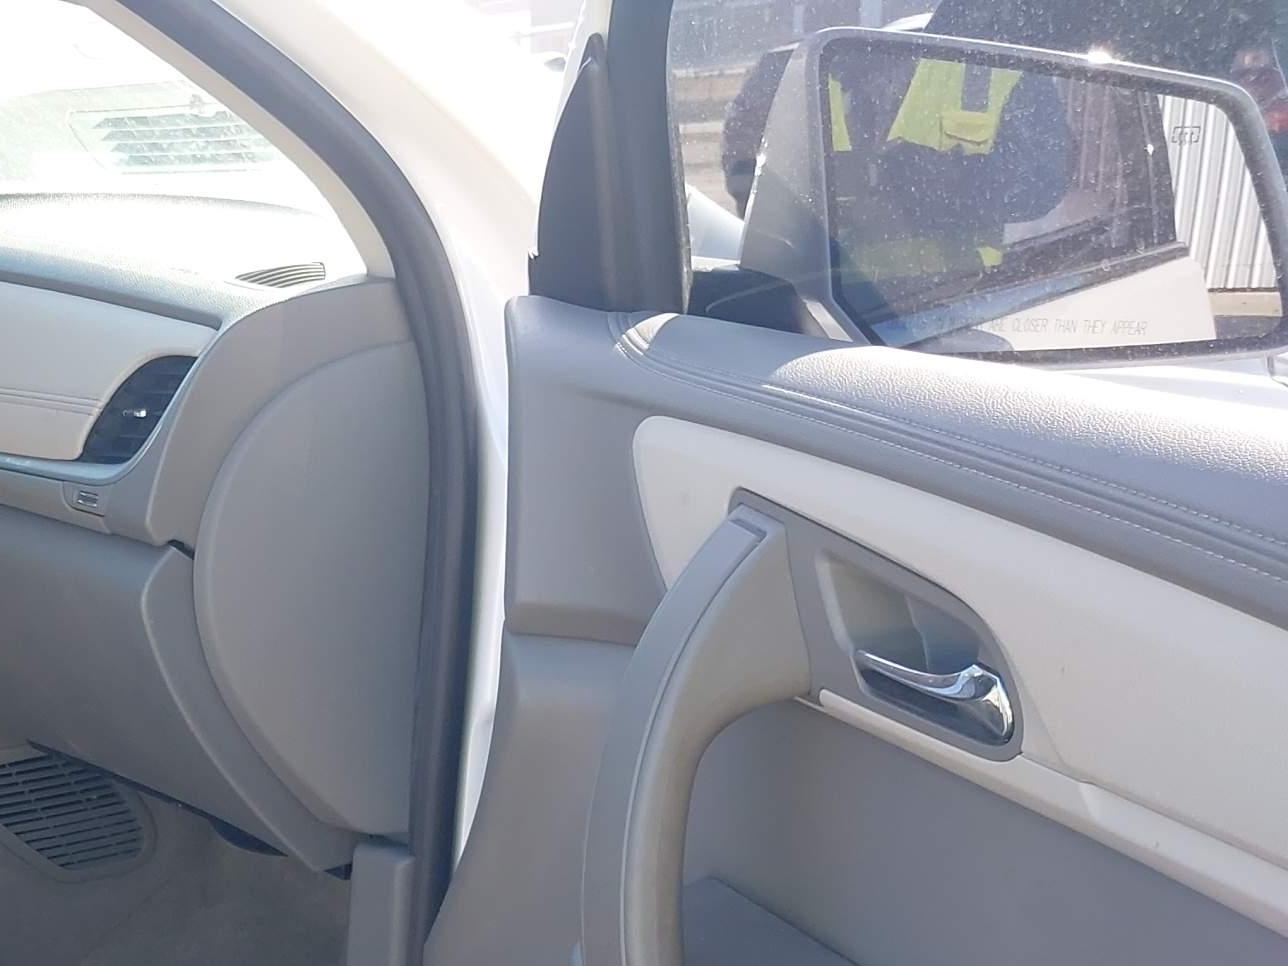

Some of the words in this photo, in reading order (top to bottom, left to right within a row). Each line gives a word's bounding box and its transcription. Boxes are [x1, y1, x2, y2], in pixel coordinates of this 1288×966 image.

[1013, 319, 1049, 334] CLOSER
[1055, 319, 1079, 335] THAN
[1082, 320, 1106, 336] THEY
[1111, 320, 1149, 337] APPEAR
